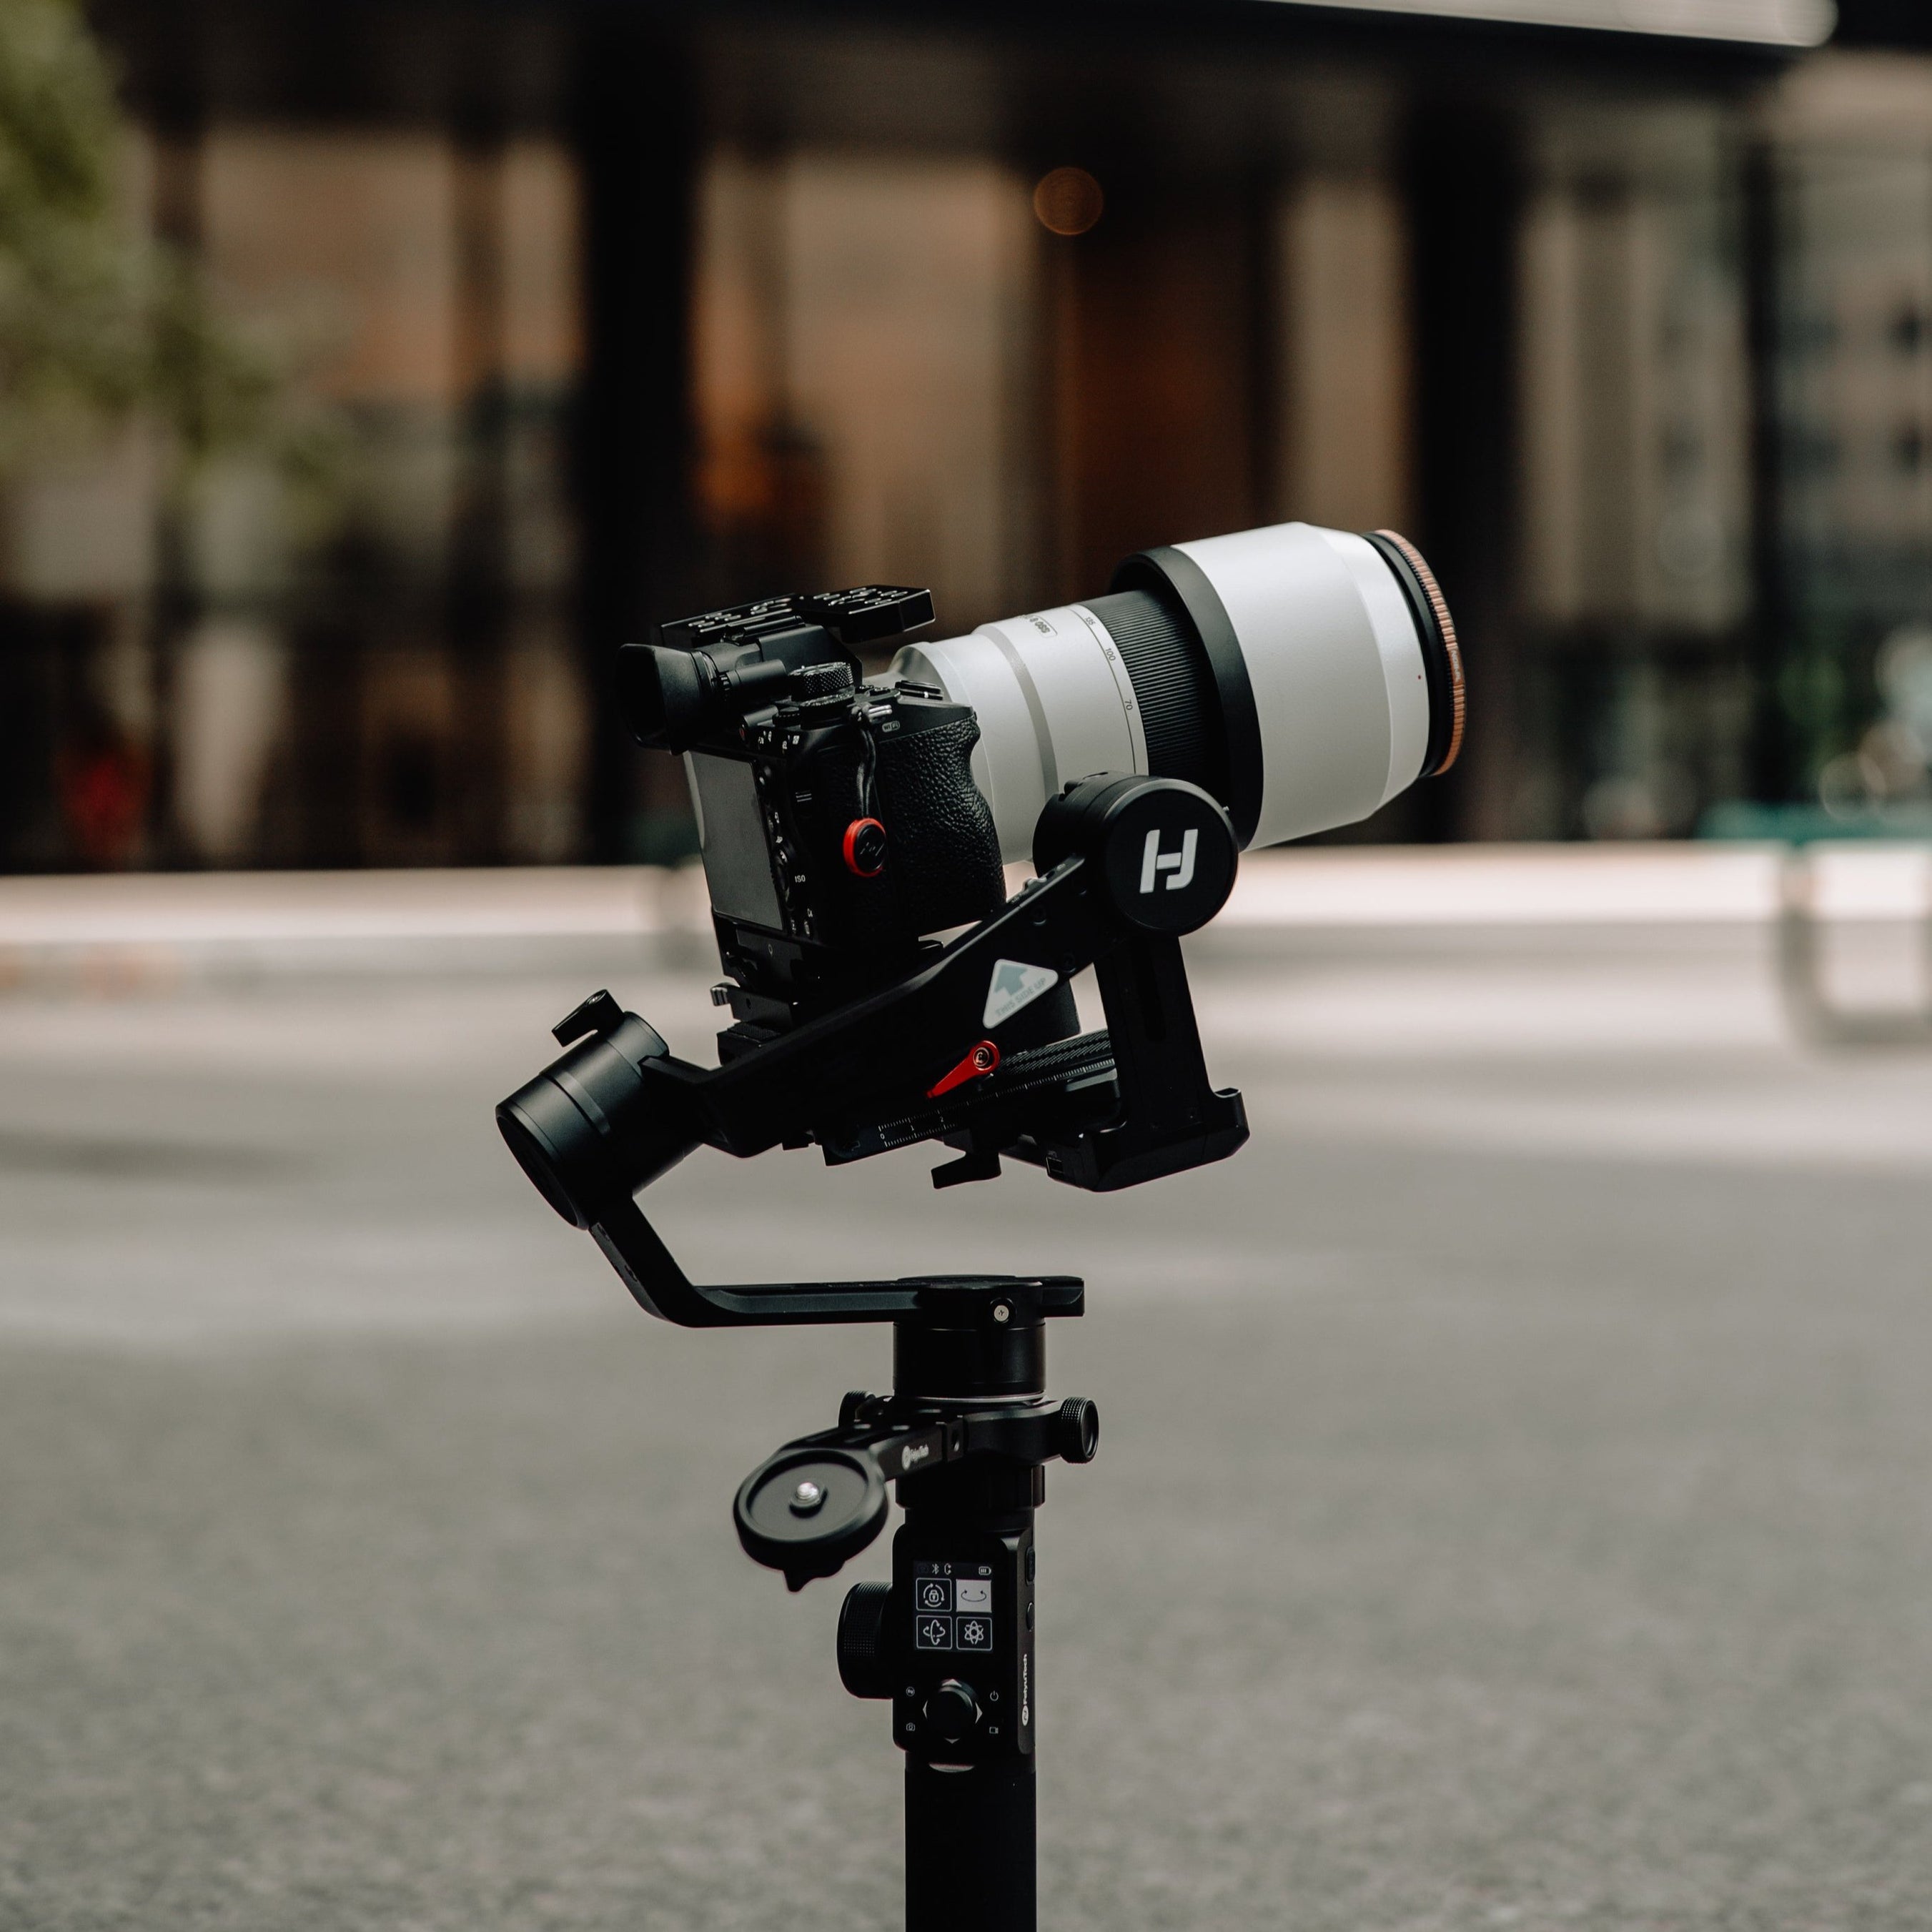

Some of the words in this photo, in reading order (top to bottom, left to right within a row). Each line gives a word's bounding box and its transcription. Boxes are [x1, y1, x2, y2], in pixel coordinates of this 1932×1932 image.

[1106, 648, 1116, 661] 100
[1124, 700, 1133, 710] 70
[794, 874, 806, 883] ISO
[996, 1001, 1016, 1016] THIS
[1016, 988, 1035, 1004] SIDE
[1034, 977, 1046, 989] UP
